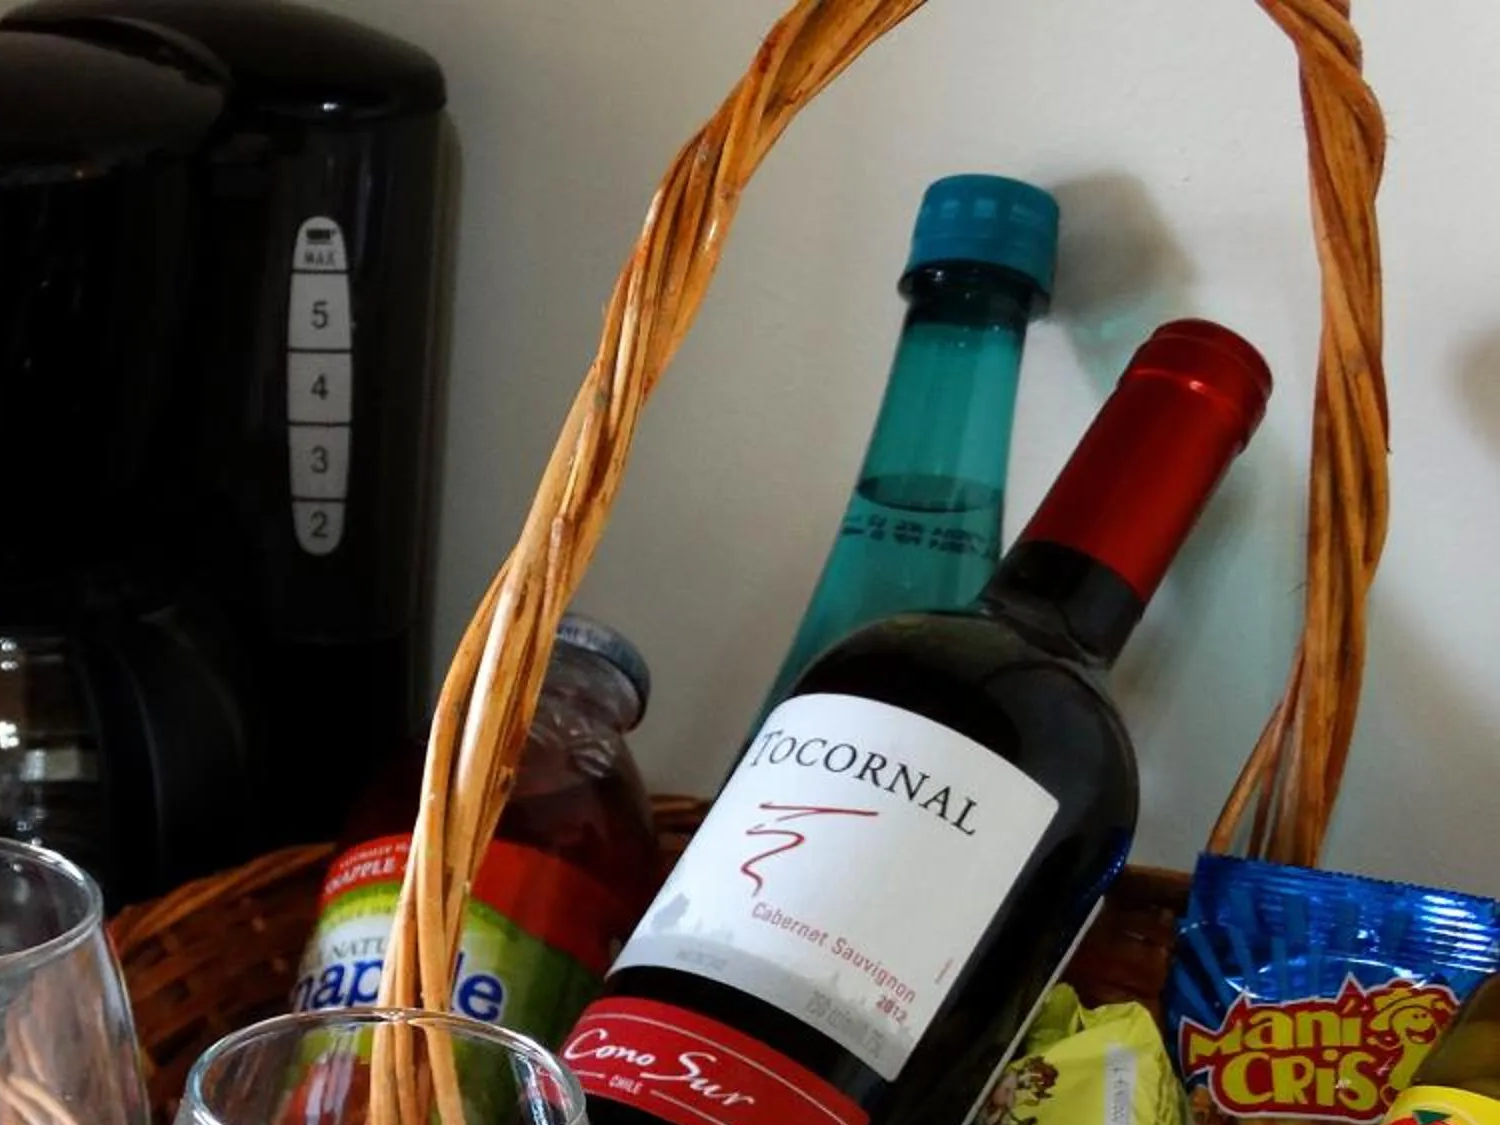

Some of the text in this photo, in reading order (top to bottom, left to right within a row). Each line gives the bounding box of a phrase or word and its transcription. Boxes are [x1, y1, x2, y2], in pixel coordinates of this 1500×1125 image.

[303, 251, 336, 266] MAX
[310, 300, 329, 329] 5
[310, 373, 329, 400] 4
[309, 445, 328, 473] 3
[309, 511, 328, 538] 2
[751, 729, 978, 837] TOCORNAL
[751, 901, 917, 1004] Cabernet Sauvignon
[564, 1028, 755, 1106] Cono Sur
